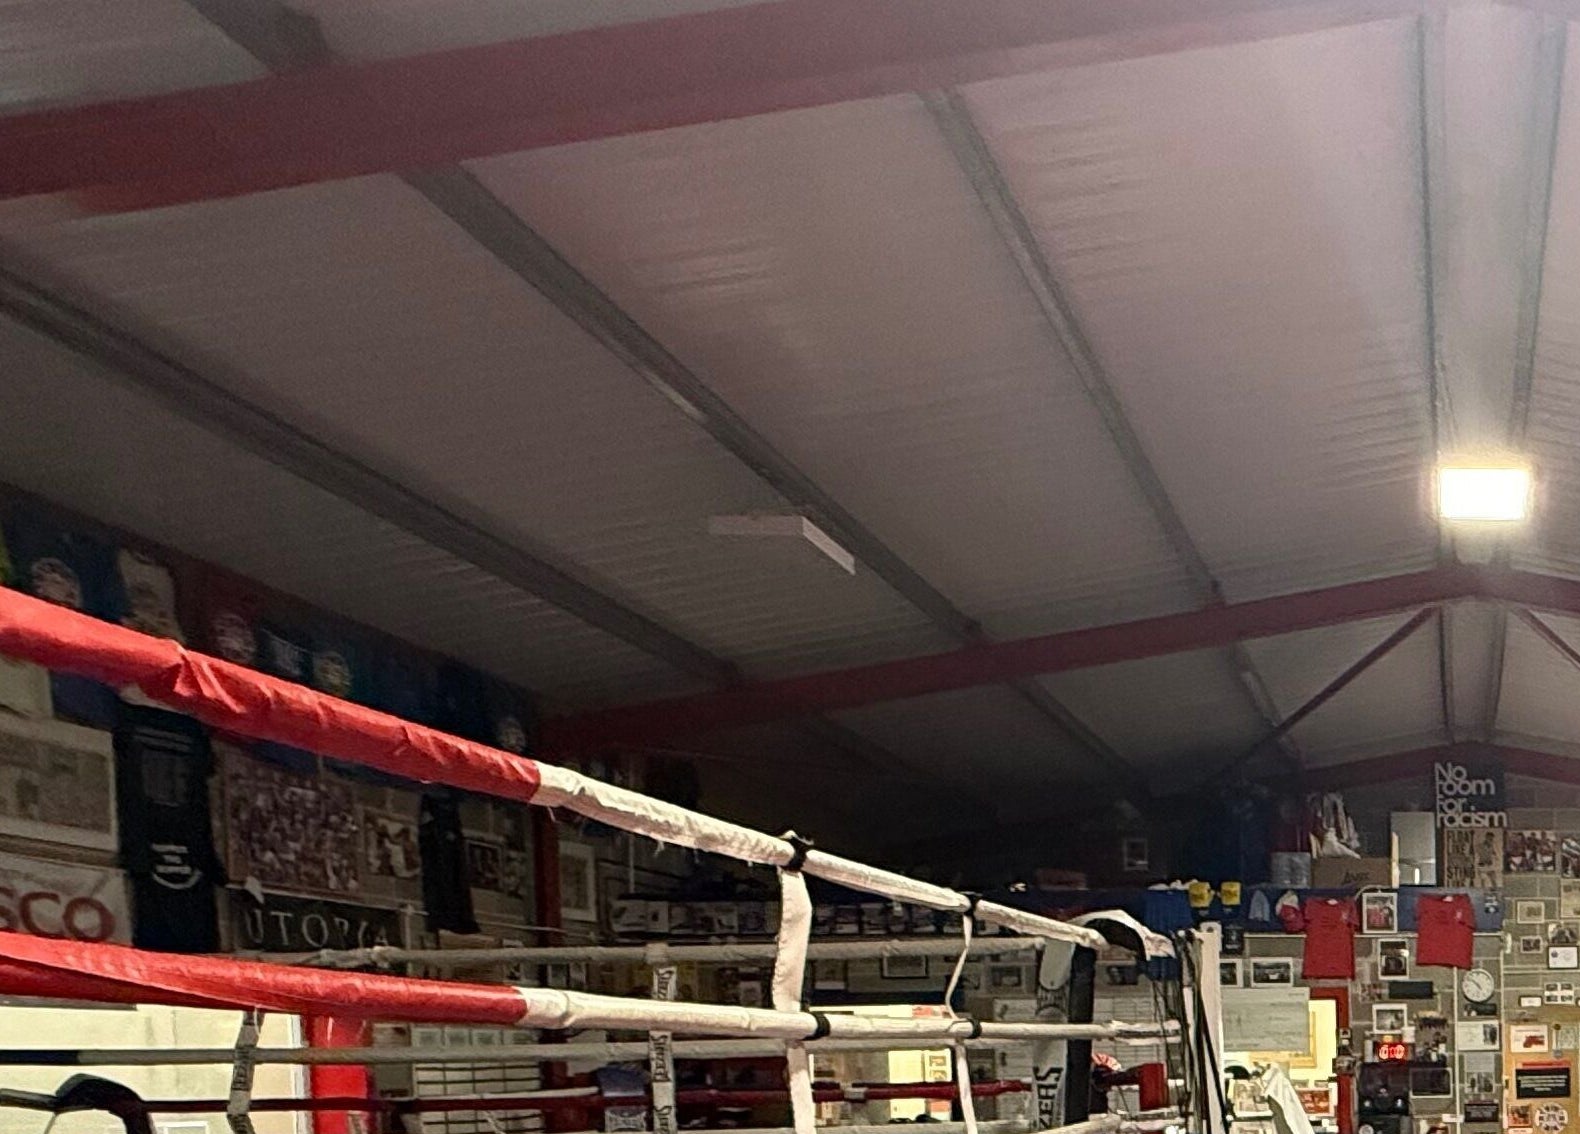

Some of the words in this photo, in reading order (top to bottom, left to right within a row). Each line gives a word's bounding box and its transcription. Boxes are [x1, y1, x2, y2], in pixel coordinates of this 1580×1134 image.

[1435, 762, 1468, 781] No
[1437, 779, 1496, 796] room
[1437, 795, 1467, 814] for
[1437, 806, 1508, 828] racism
